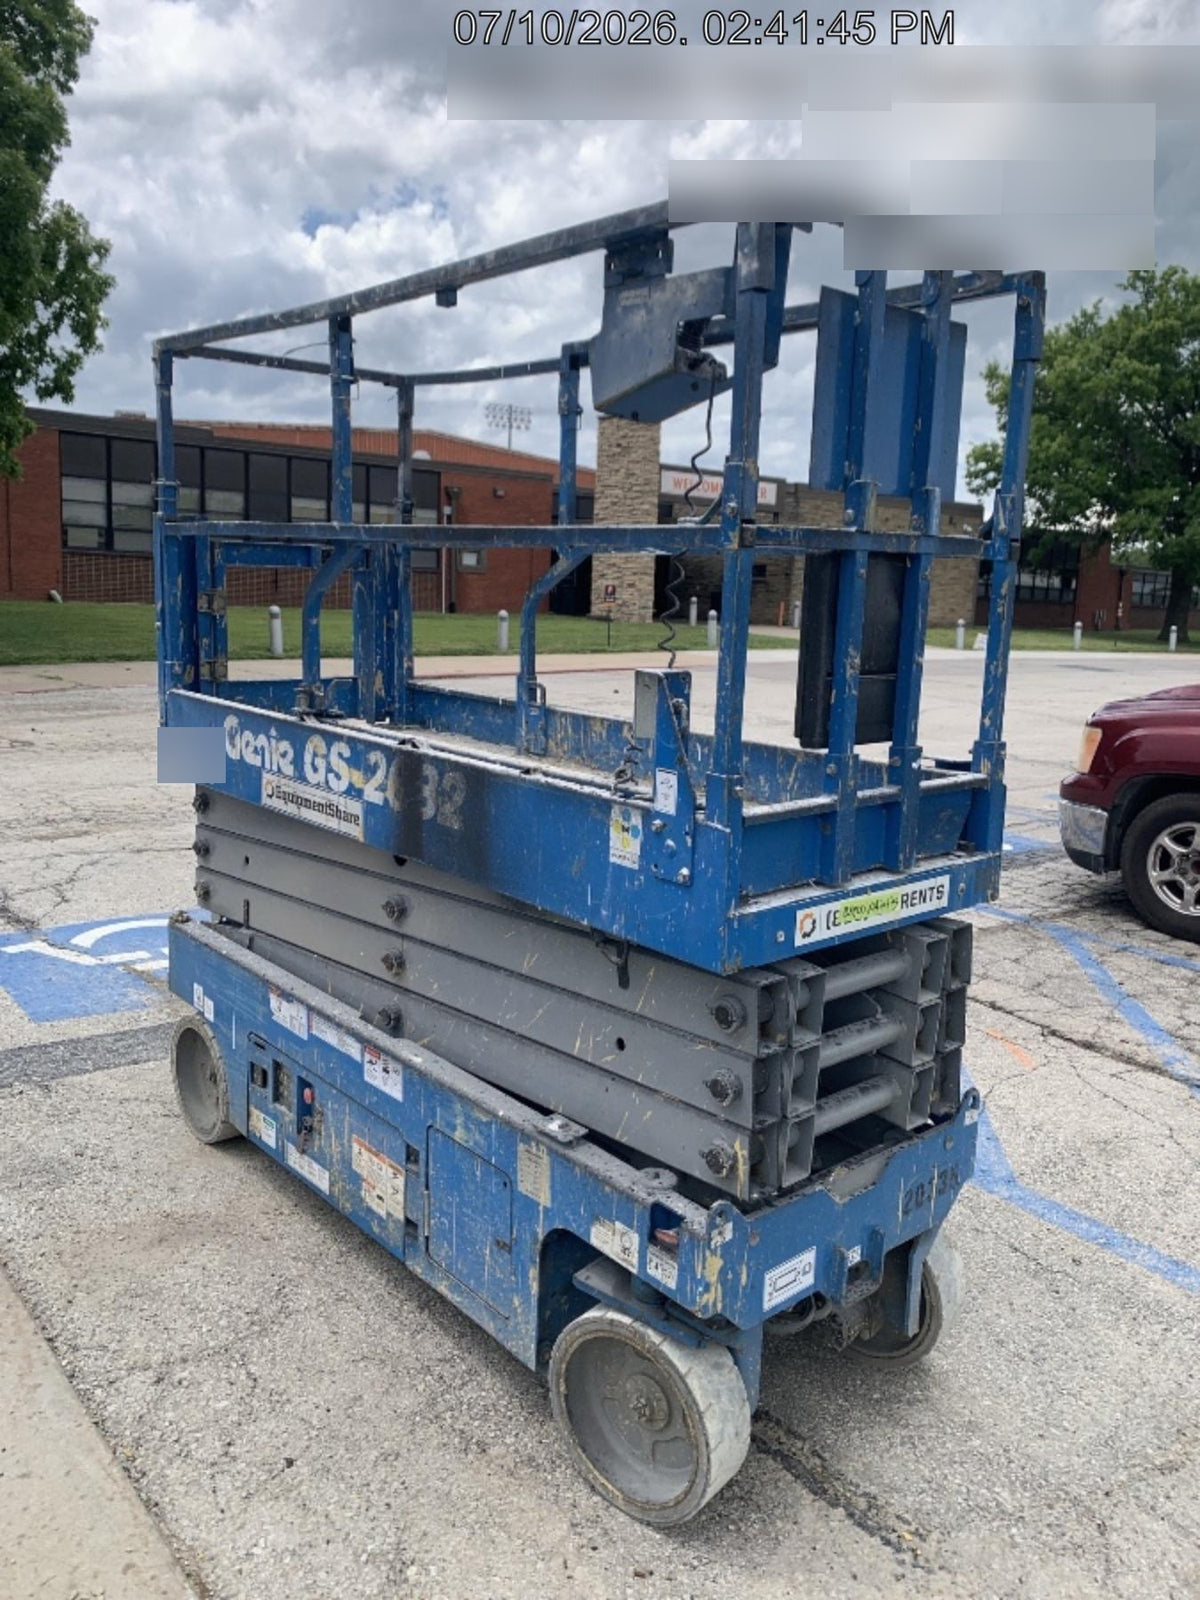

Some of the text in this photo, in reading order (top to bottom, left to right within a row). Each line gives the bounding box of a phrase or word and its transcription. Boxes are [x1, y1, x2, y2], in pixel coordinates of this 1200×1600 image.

[672, 475, 722, 495] WEOM
[224, 714, 295, 777] Genie
[275, 785, 361, 826] EquipmentShare
[900, 884, 945, 910] RENTS
